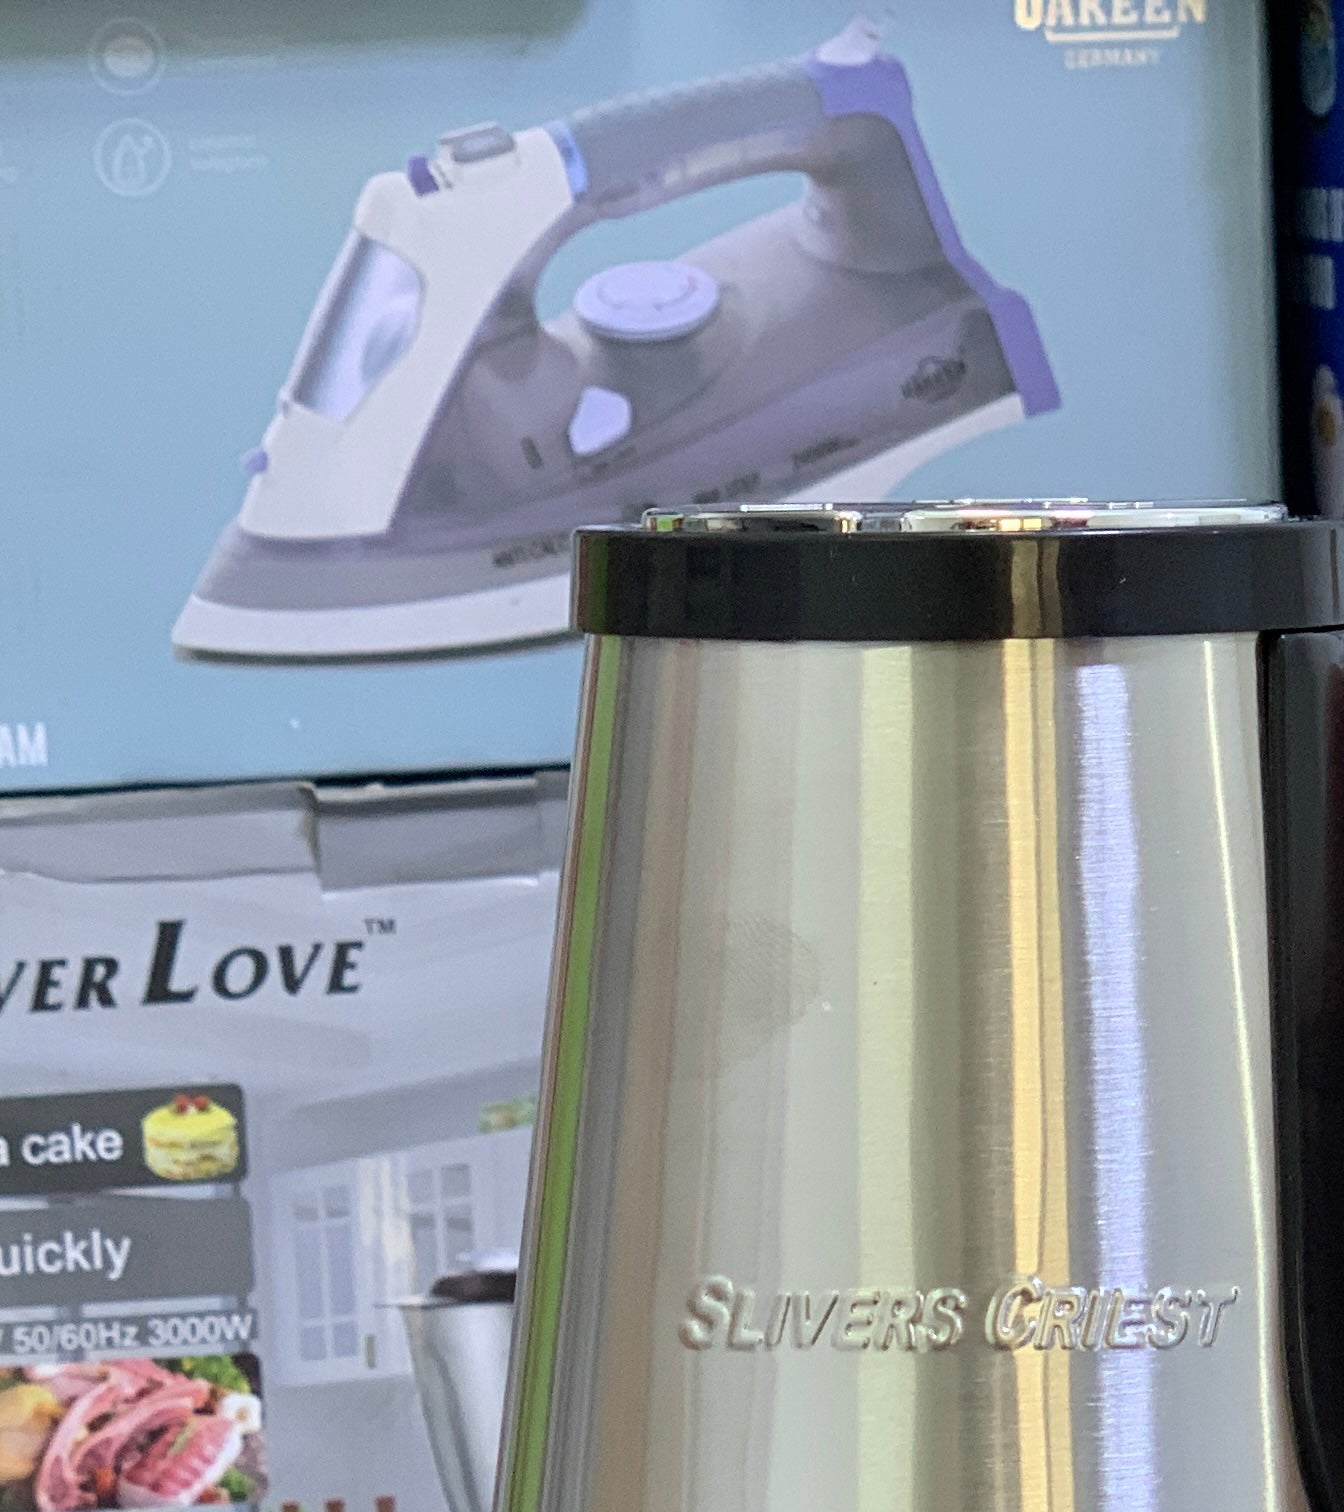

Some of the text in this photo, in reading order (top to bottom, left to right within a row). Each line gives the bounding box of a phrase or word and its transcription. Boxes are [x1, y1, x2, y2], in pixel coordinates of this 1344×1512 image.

[1064, 49, 1161, 69] GERMANY
[141, 920, 366, 1006] LOVE
[21, 1122, 124, 1166] cake
[13, 1319, 139, 1354] 50/60Hz
[148, 1313, 253, 1344] 3000W
[678, 1274, 1242, 1351] SLIVERS CRIEST
